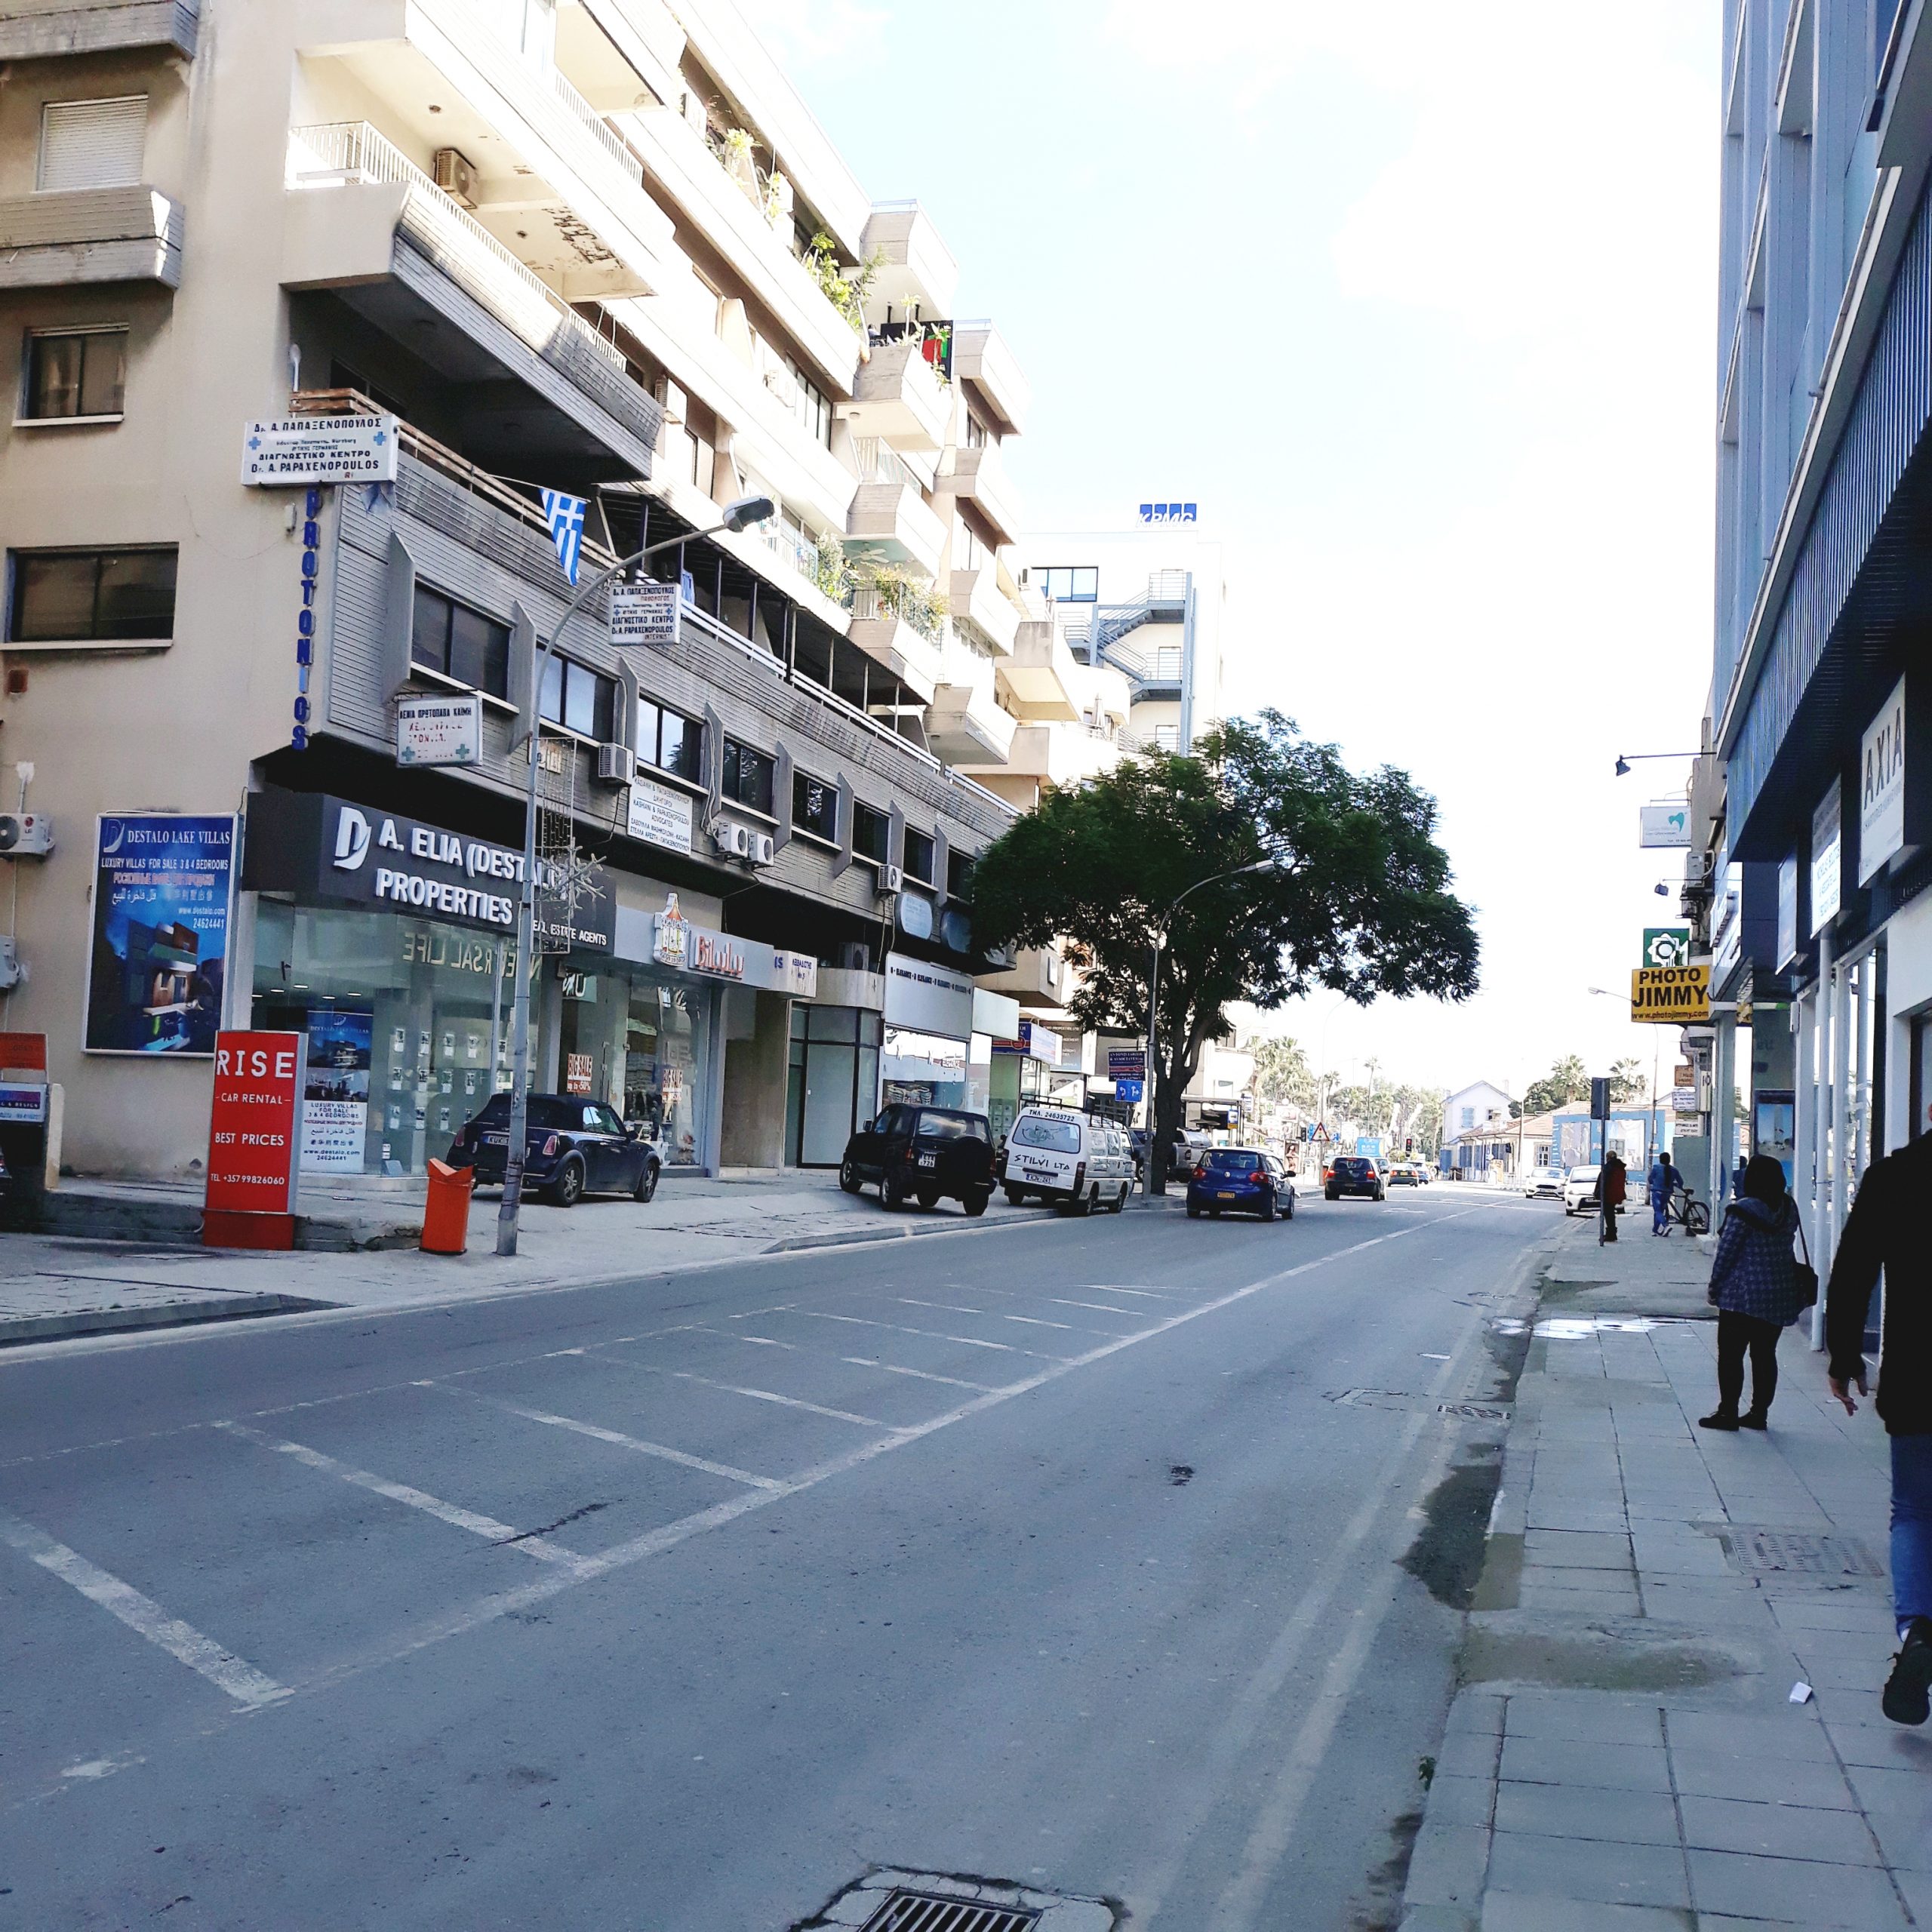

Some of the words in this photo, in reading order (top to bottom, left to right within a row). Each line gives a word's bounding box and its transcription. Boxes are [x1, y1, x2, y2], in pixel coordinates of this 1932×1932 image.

[259, 451, 325, 460] ΔΙΑΓΝΩΣΤΙΚΟ
[280, 460, 380, 472] PAPAXENOPOULOS
[1136, 507, 1196, 528] KPMG
[651, 615, 674, 623] ΚΕΝΤΡΟ
[1864, 706, 1903, 811] AXIA
[128, 830, 169, 844] DESTALO
[172, 830, 195, 844] LAKE
[198, 831, 230, 844] VILLAS
[126, 858, 146, 869] VILLAS
[149, 859, 161, 869] FOR
[162, 859, 177, 869] SALE
[195, 860, 229, 870] BEDROOMS
[378, 818, 405, 852] A.
[411, 827, 463, 867] ELIA
[466, 842, 568, 900] (DESTL
[375, 868, 513, 925] PROPERTIES
[578, 930, 607, 946] AGENTS
[1638, 968, 1701, 984] PHOTO
[1632, 985, 1708, 1008] JIMMY
[1632, 1010, 1709, 1020] www.photojimmy.com
[216, 1050, 295, 1078] RISE
[221, 1093, 238, 1103] CAR
[242, 1094, 283, 1104] RENTAL
[214, 1133, 235, 1144] BEST
[242, 1134, 285, 1146] PRICES
[211, 1173, 221, 1182] TEL
